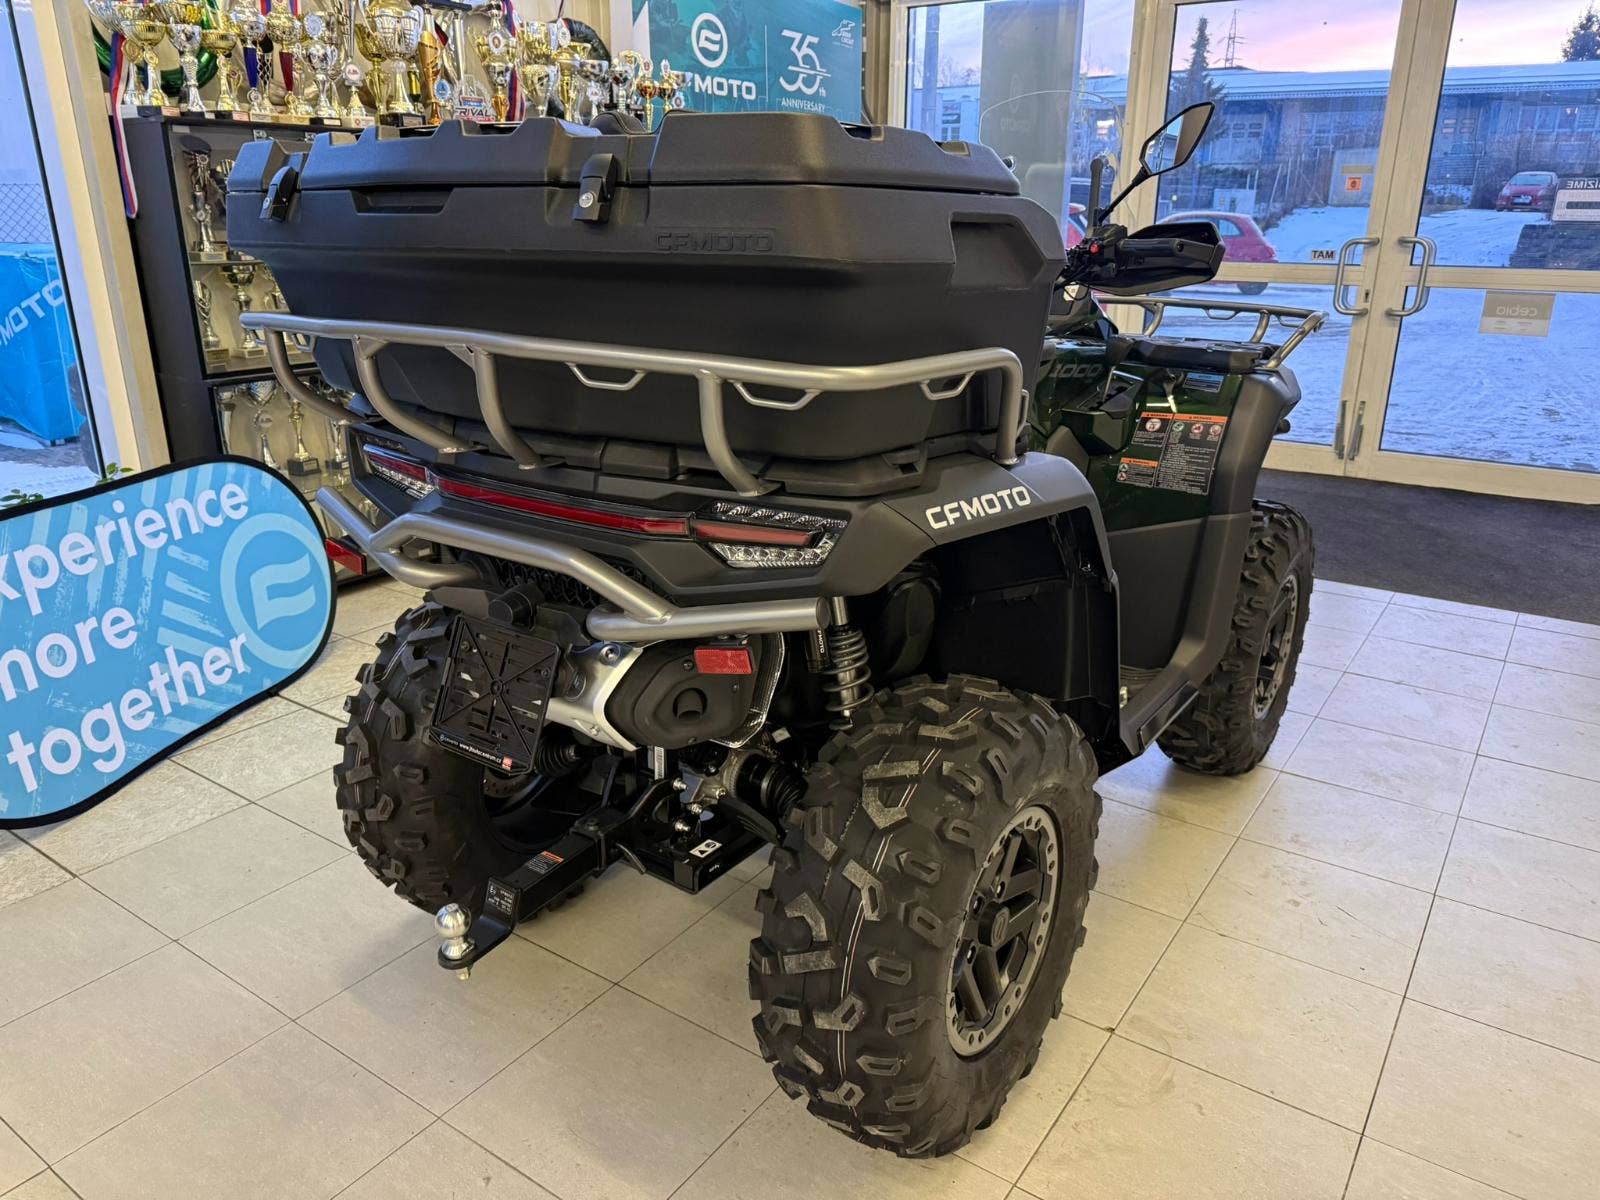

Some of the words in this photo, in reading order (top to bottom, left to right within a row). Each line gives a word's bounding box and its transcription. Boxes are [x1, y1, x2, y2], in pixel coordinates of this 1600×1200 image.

[684, 71, 757, 101] MOTO
[455, 106, 489, 117] RIVAL
[781, 96, 825, 112] ANNIVERSARY
[656, 232, 773, 253] CFMOTO
[925, 485, 1032, 530] CFMOTO
[6, 632, 248, 793] together
